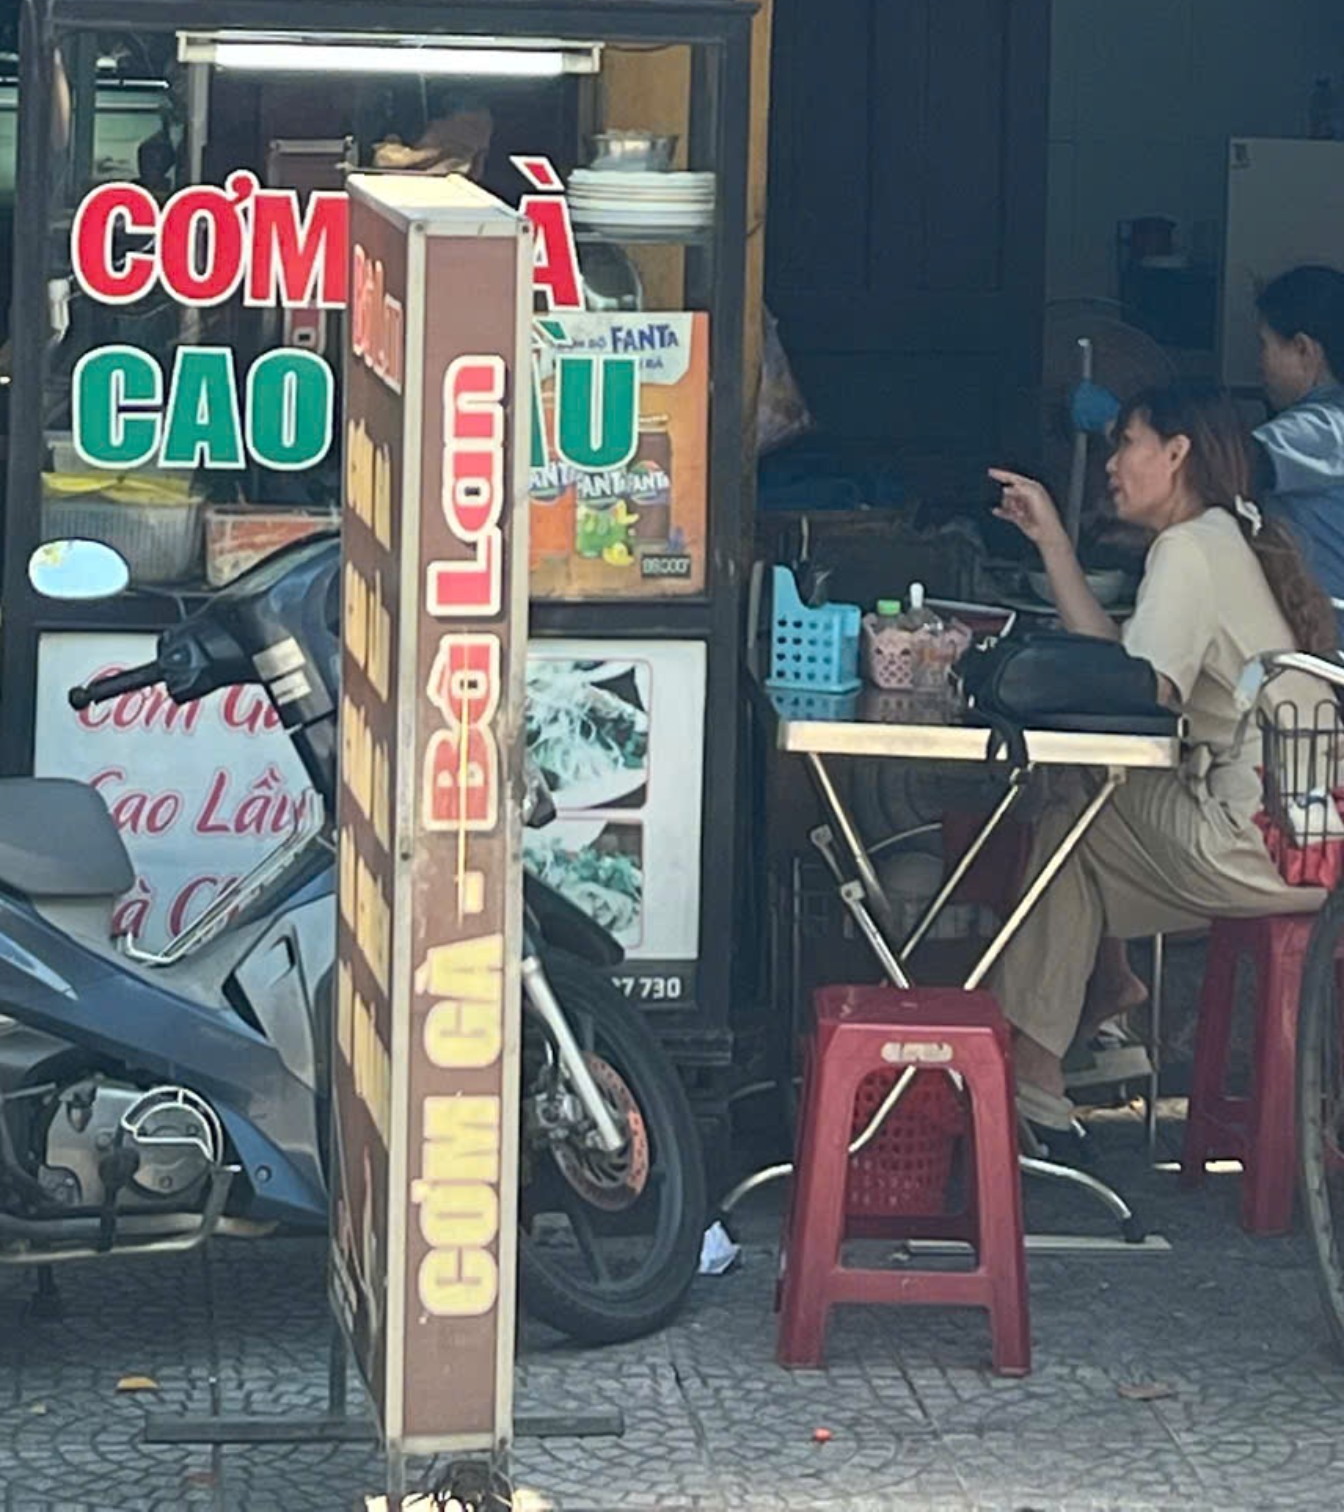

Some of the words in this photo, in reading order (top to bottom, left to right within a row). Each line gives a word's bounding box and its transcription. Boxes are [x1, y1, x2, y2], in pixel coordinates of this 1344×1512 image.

[72, 168, 348, 308] CƠM
[610, 323, 679, 354] FANTA
[73, 345, 334, 470] CAO
[425, 355, 508, 616] Lan
[415, 933, 503, 1068] GÀ
[639, 976, 681, 999] 730
[412, 1095, 501, 1316] CƠM
